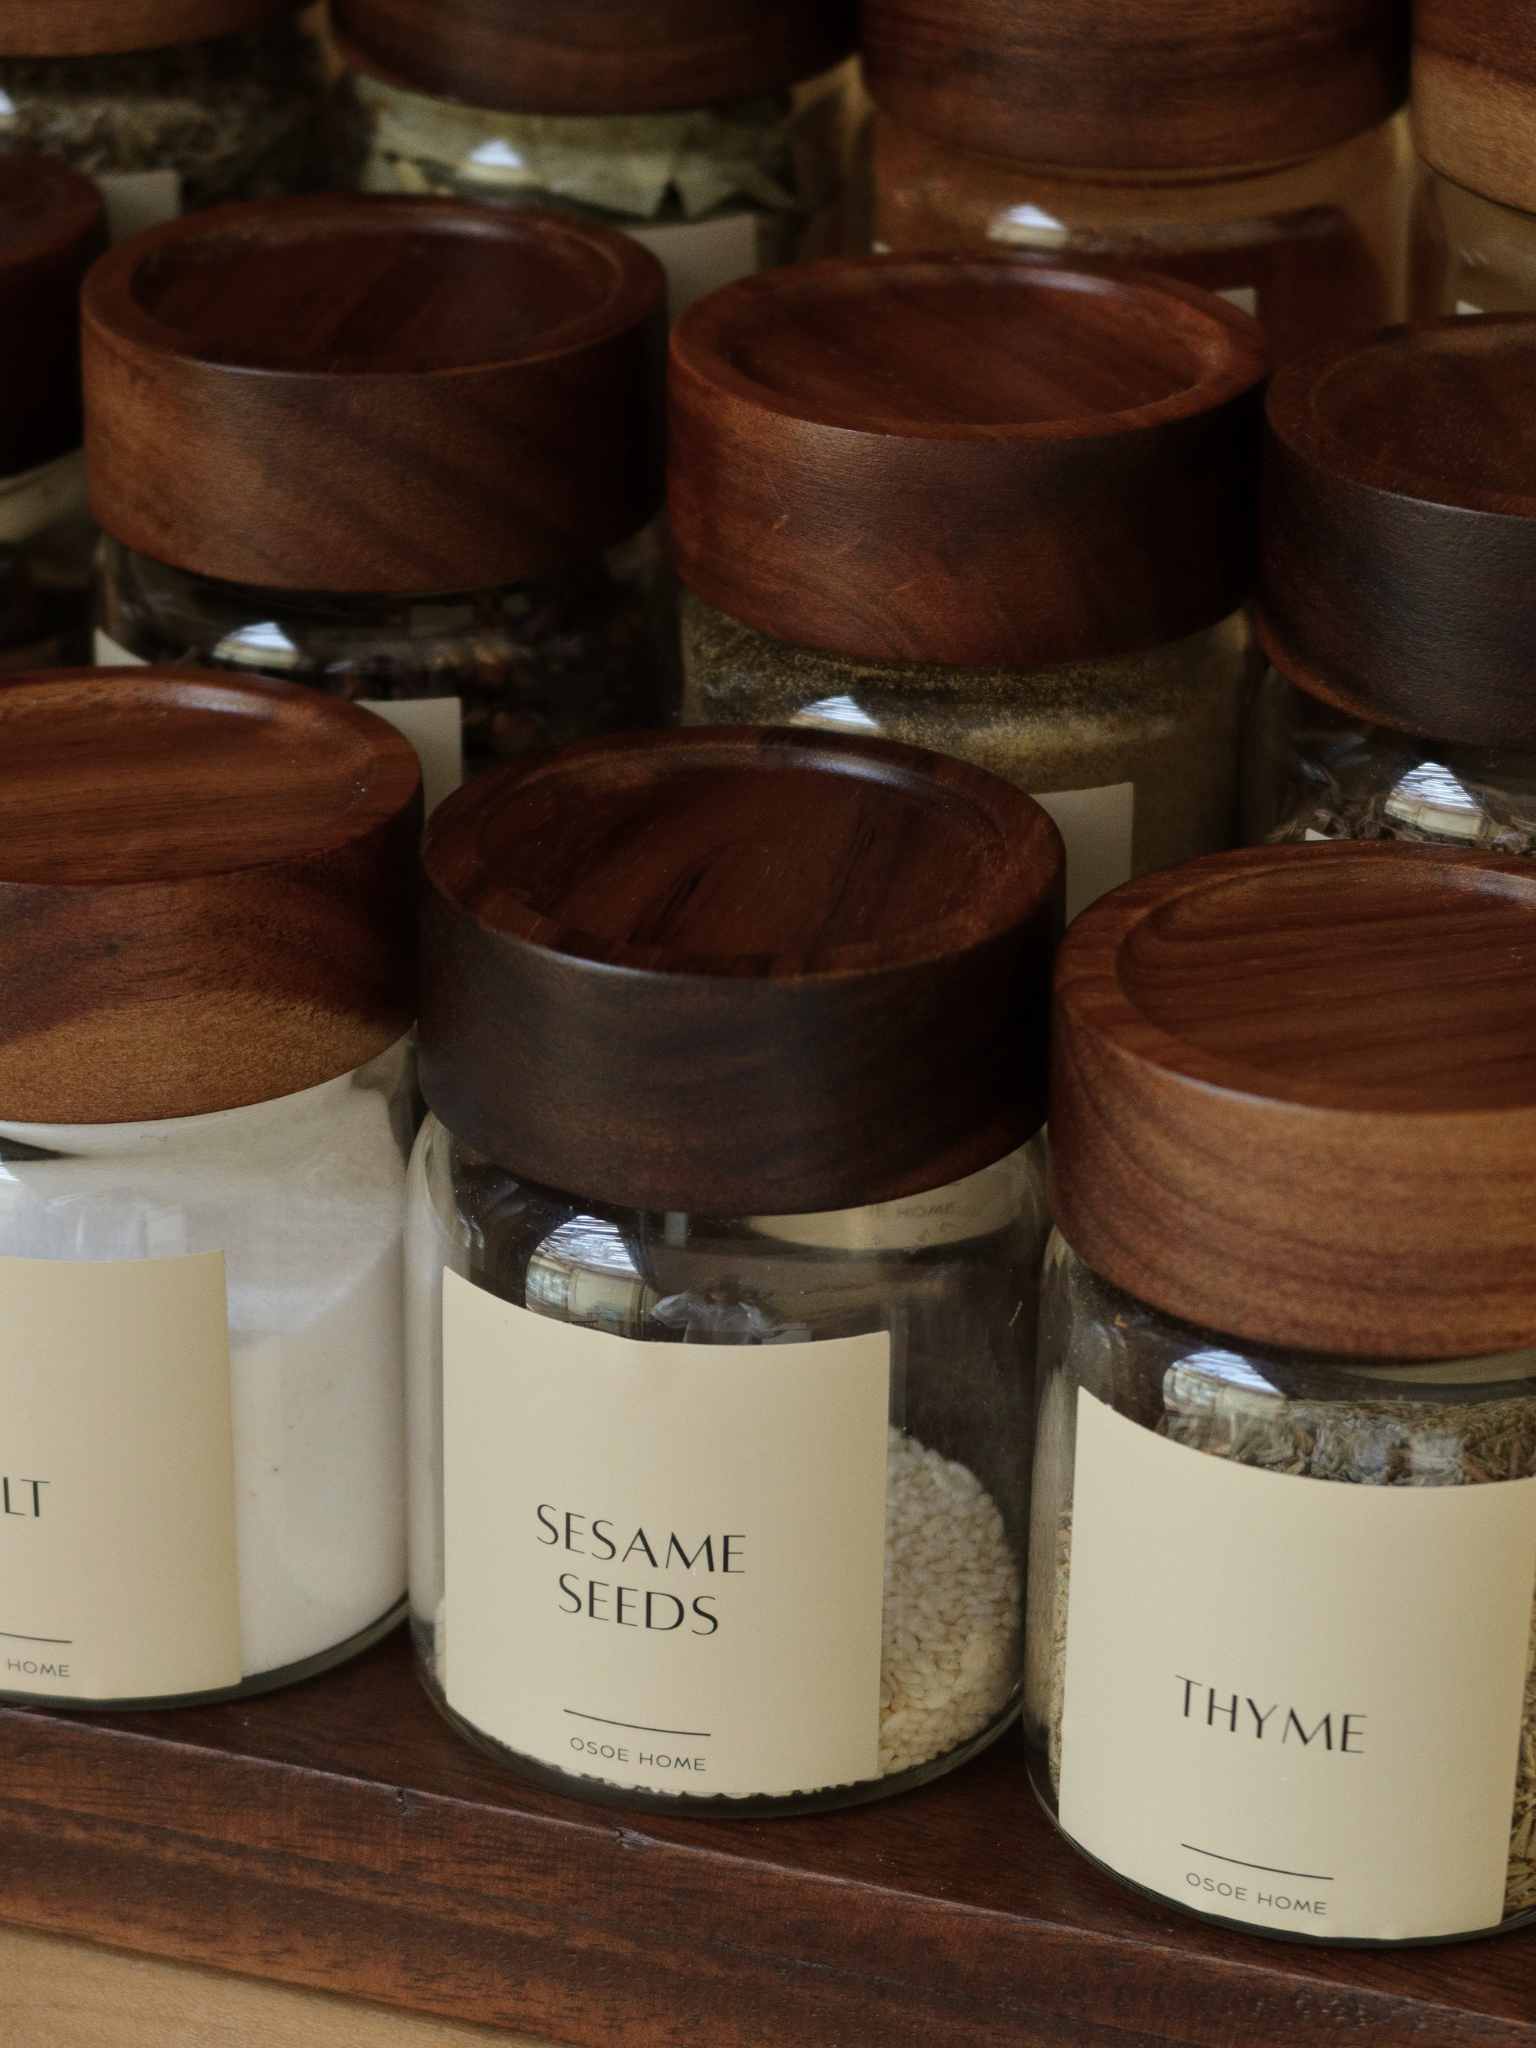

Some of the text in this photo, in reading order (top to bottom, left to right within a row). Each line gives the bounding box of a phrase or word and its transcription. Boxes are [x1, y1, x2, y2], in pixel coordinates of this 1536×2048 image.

[536, 1502, 747, 1575] SESAME
[558, 1572, 720, 1637] SEEDS
[7, 1658, 71, 1679] HOME
[1174, 1674, 1368, 1755] THYME
[569, 1736, 707, 1773] OSOE HOME
[1185, 1871, 1328, 1916] OSOE HOME
